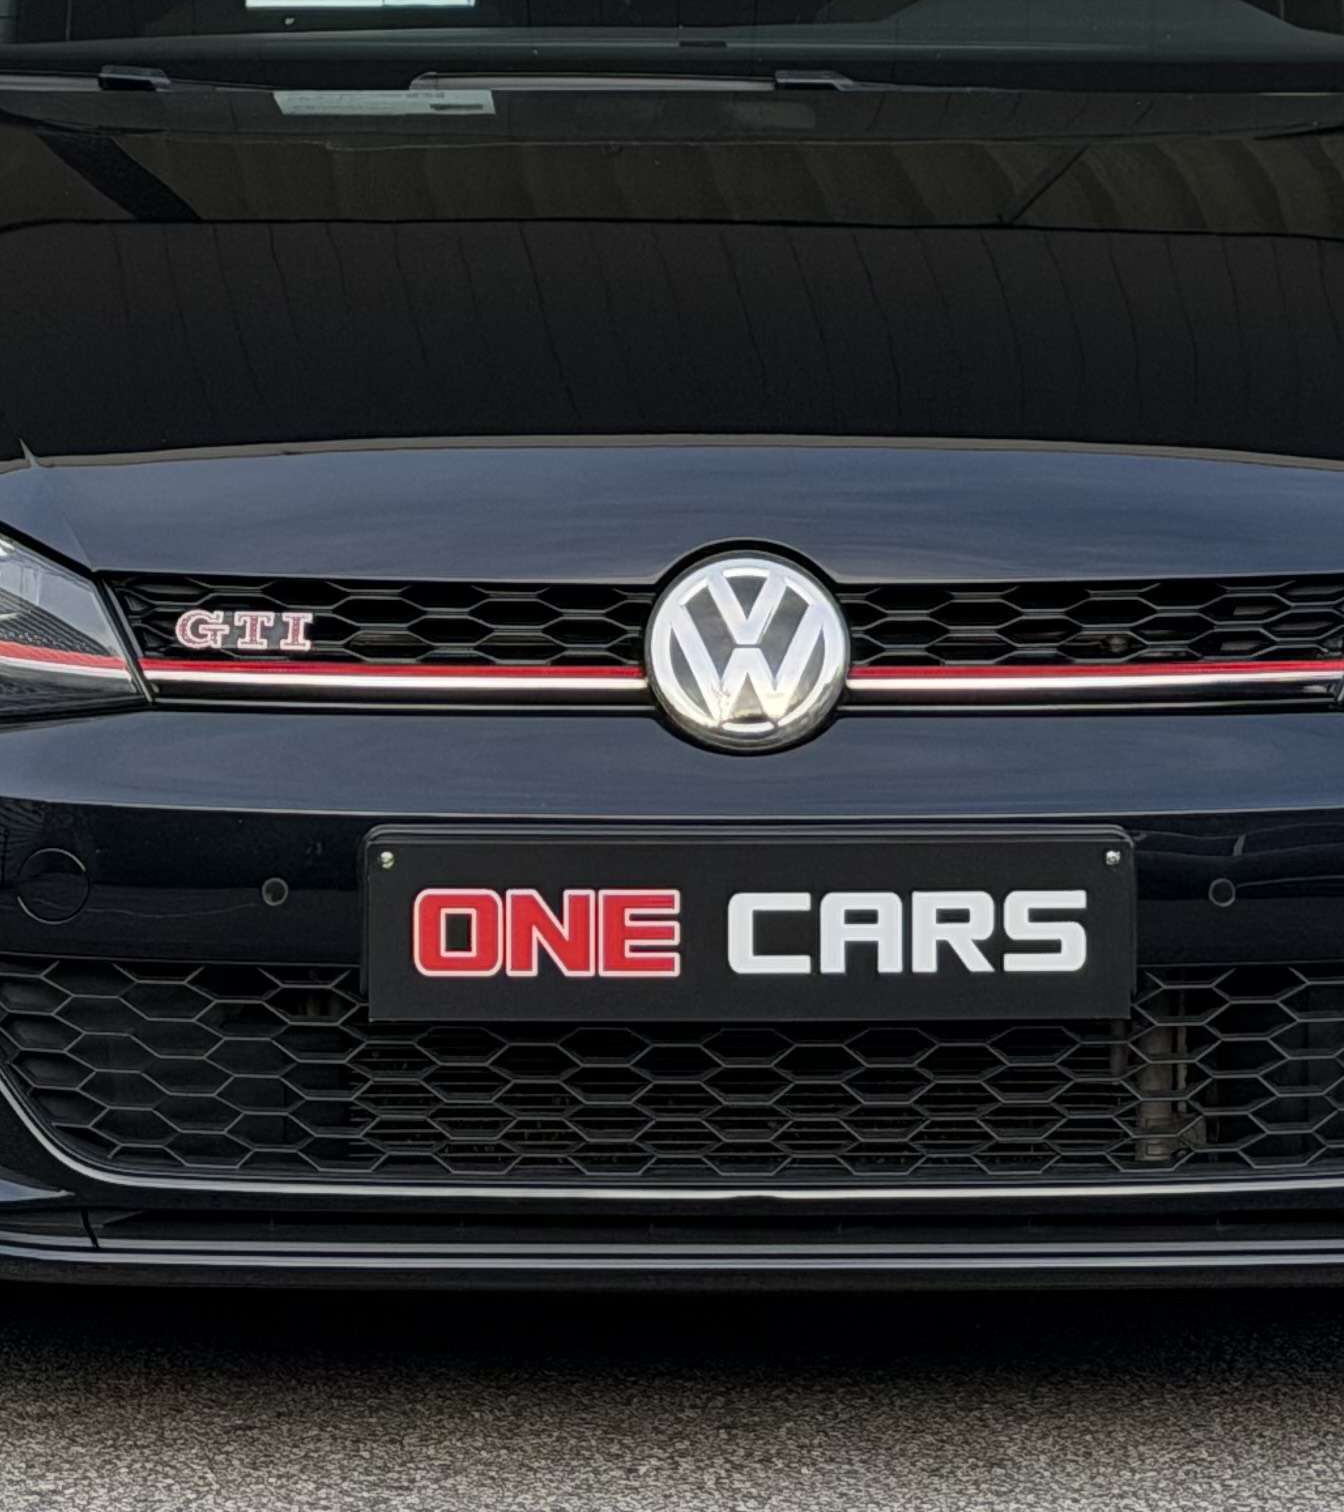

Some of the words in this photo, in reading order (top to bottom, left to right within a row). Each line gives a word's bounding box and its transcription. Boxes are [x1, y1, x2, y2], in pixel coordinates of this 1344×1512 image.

[175, 609, 314, 651] GTI
[659, 556, 837, 731] VW
[413, 888, 681, 978] ONE
[727, 890, 1087, 974] CARS
